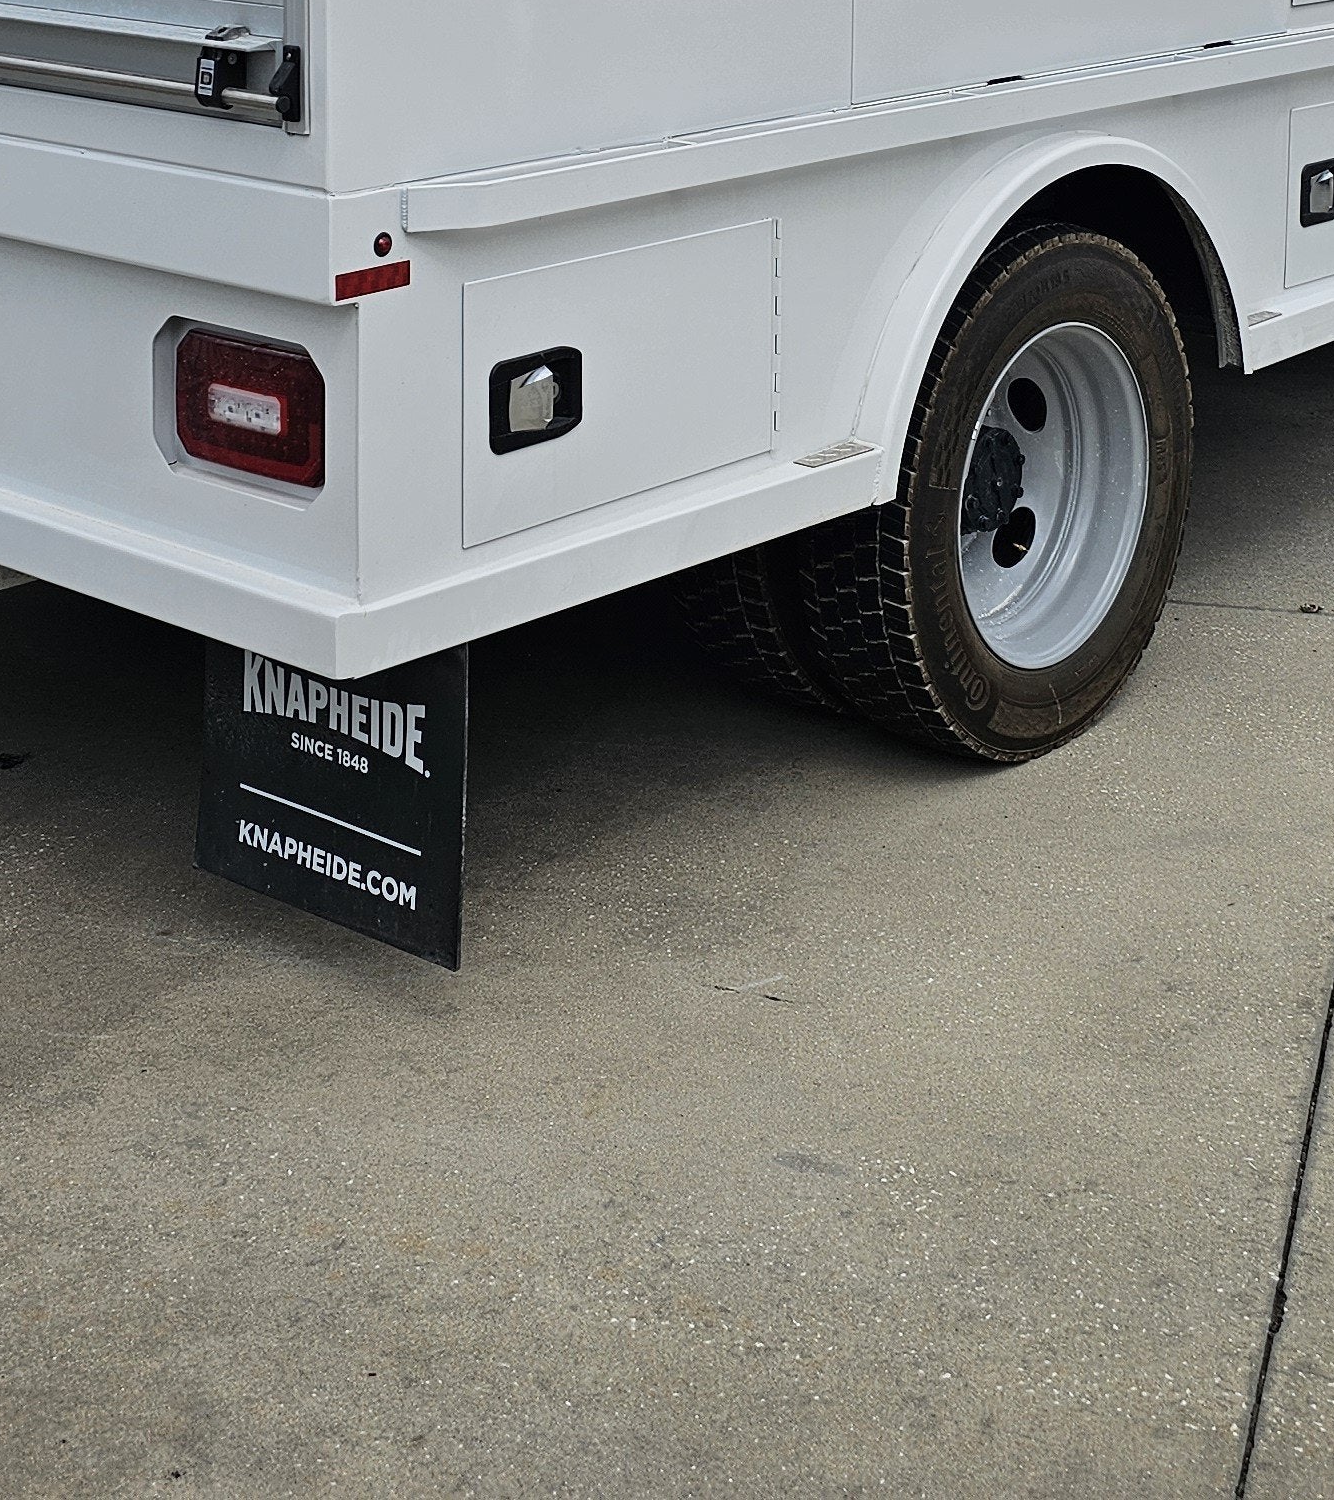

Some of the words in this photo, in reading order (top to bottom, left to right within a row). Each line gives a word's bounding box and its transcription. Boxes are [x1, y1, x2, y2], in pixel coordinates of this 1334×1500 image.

[290, 732, 334, 762] SINCE
[336, 748, 369, 774] 1848
[238, 819, 417, 911] KNAPHEIDE.COM
